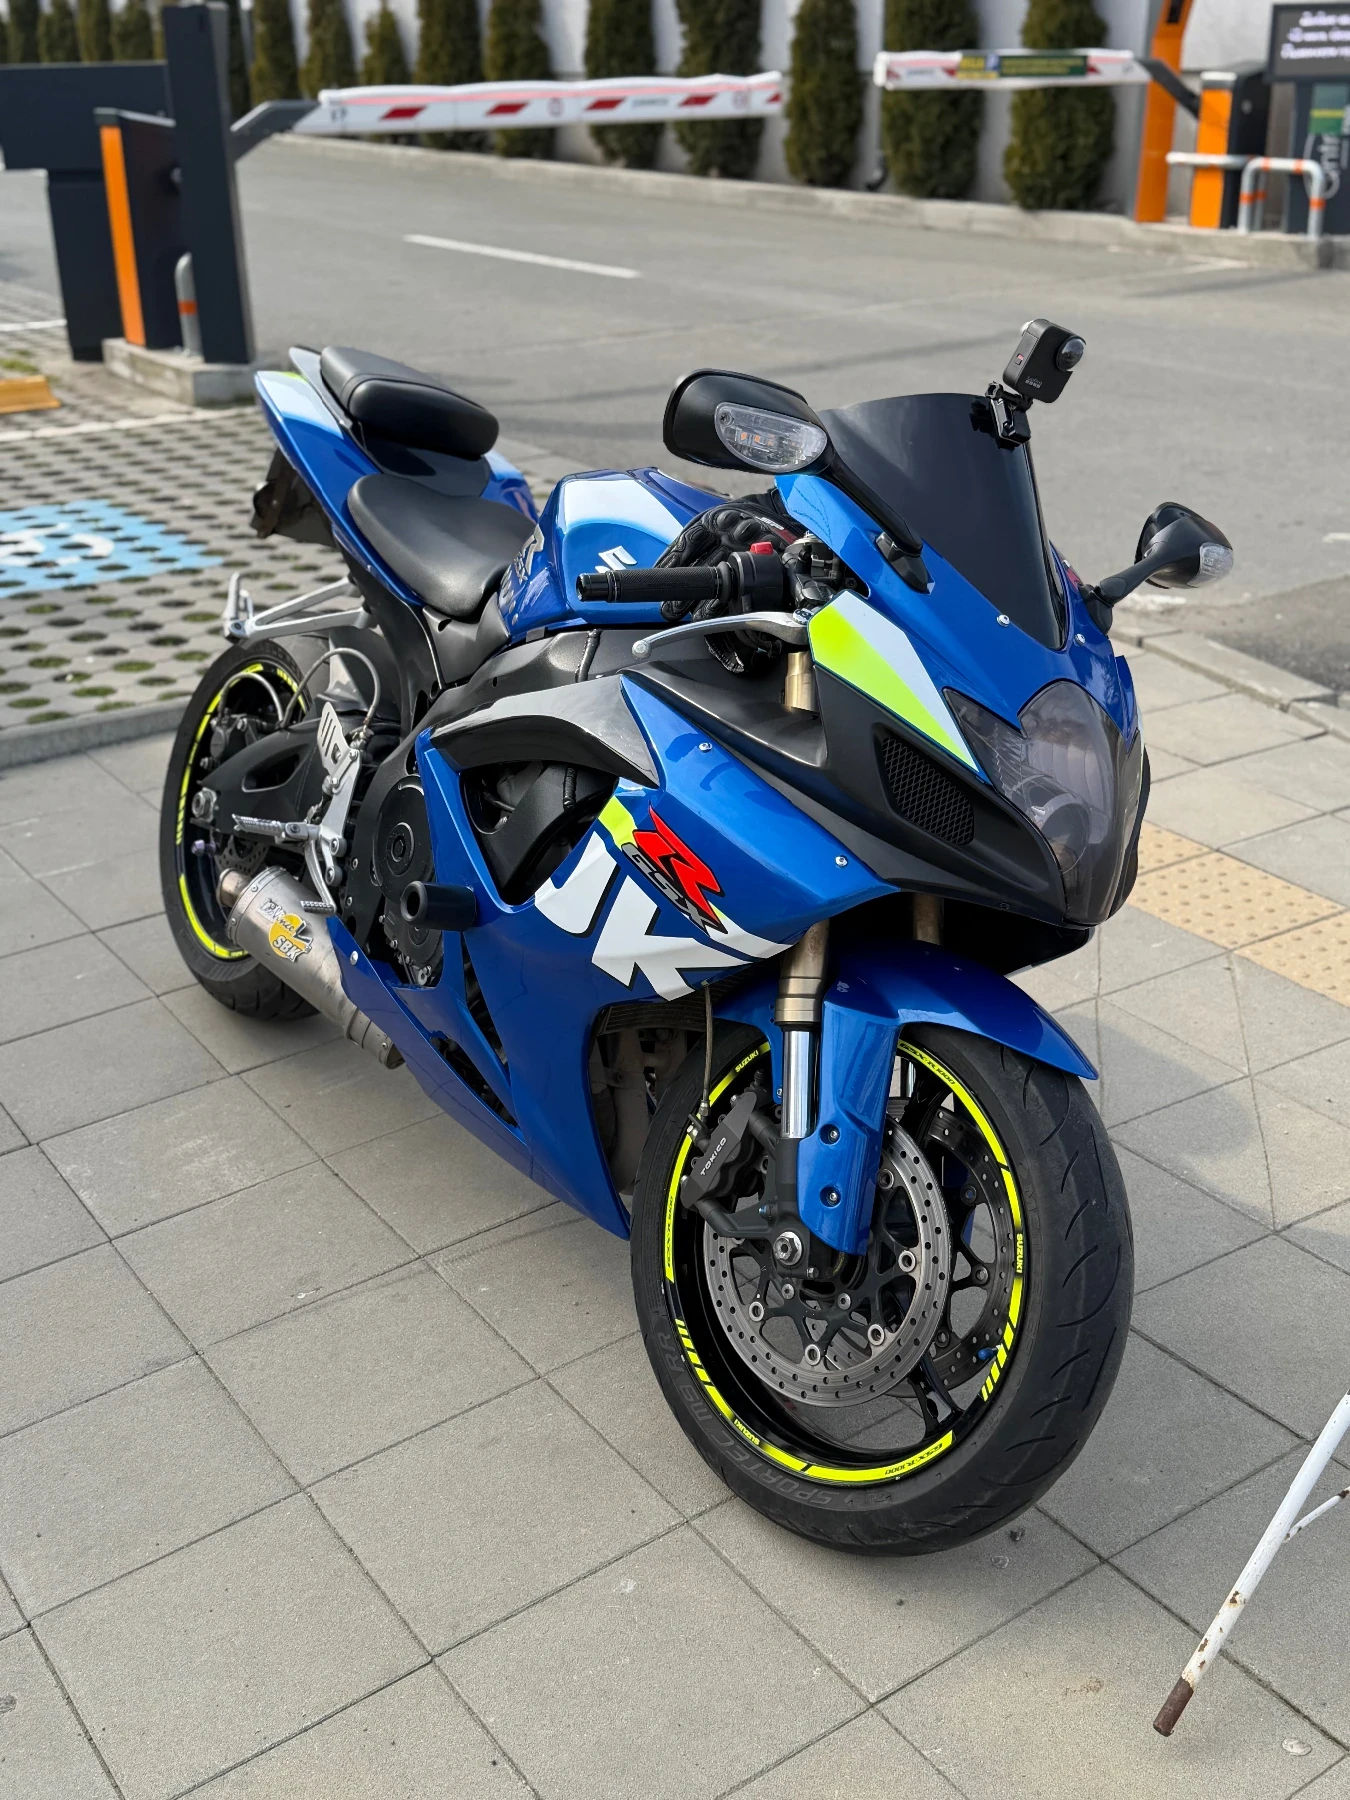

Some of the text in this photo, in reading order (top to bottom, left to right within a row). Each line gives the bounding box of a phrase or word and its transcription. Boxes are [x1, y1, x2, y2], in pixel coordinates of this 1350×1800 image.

[273, 935, 304, 962] SBK
[734, 1050, 759, 1073] SUZUKI
[700, 1137, 727, 1176] TOKICO
[1016, 1232, 1024, 1274] SUZUKI
[657, 1331, 840, 1506] SPORTEC M9 RR
[733, 1417, 760, 1445] SUZUKI
